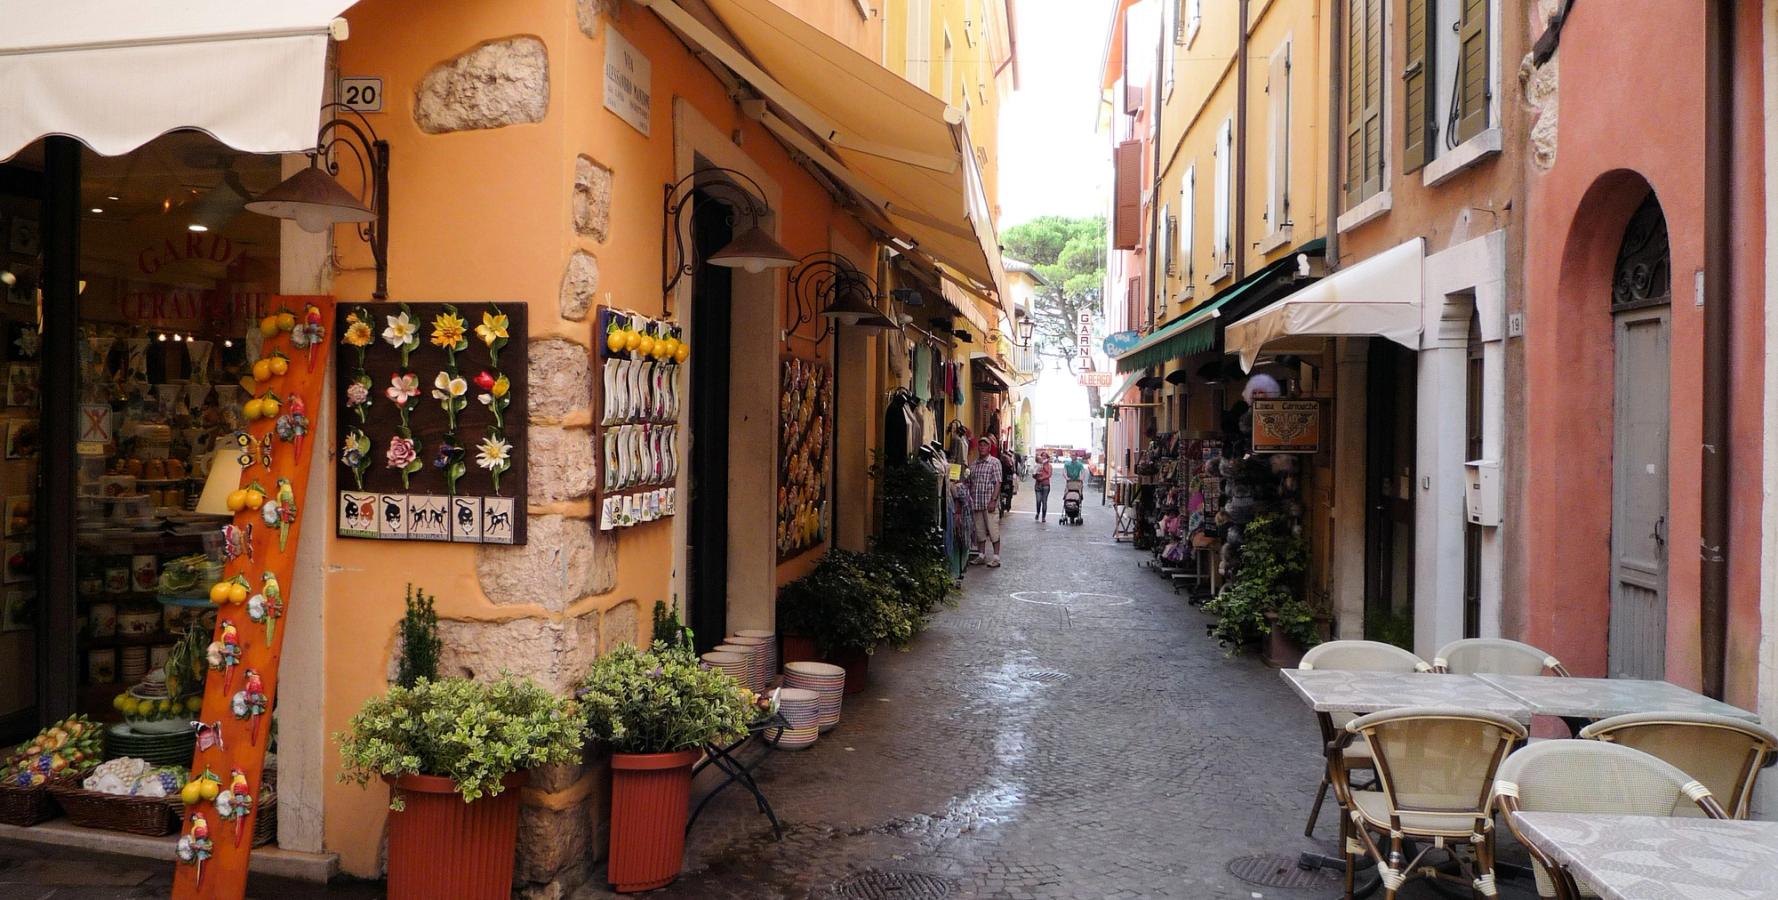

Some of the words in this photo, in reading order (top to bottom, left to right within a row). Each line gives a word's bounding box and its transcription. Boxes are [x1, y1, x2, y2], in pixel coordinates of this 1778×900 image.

[624, 51, 634, 73] VIA
[346, 85, 376, 105] 20
[138, 231, 248, 279] GARDA
[120, 291, 269, 320] CERAMHE
[1511, 317, 1520, 333] 19
[1080, 314, 1089, 367] GARNI
[1079, 374, 1110, 385] ALBERGO
